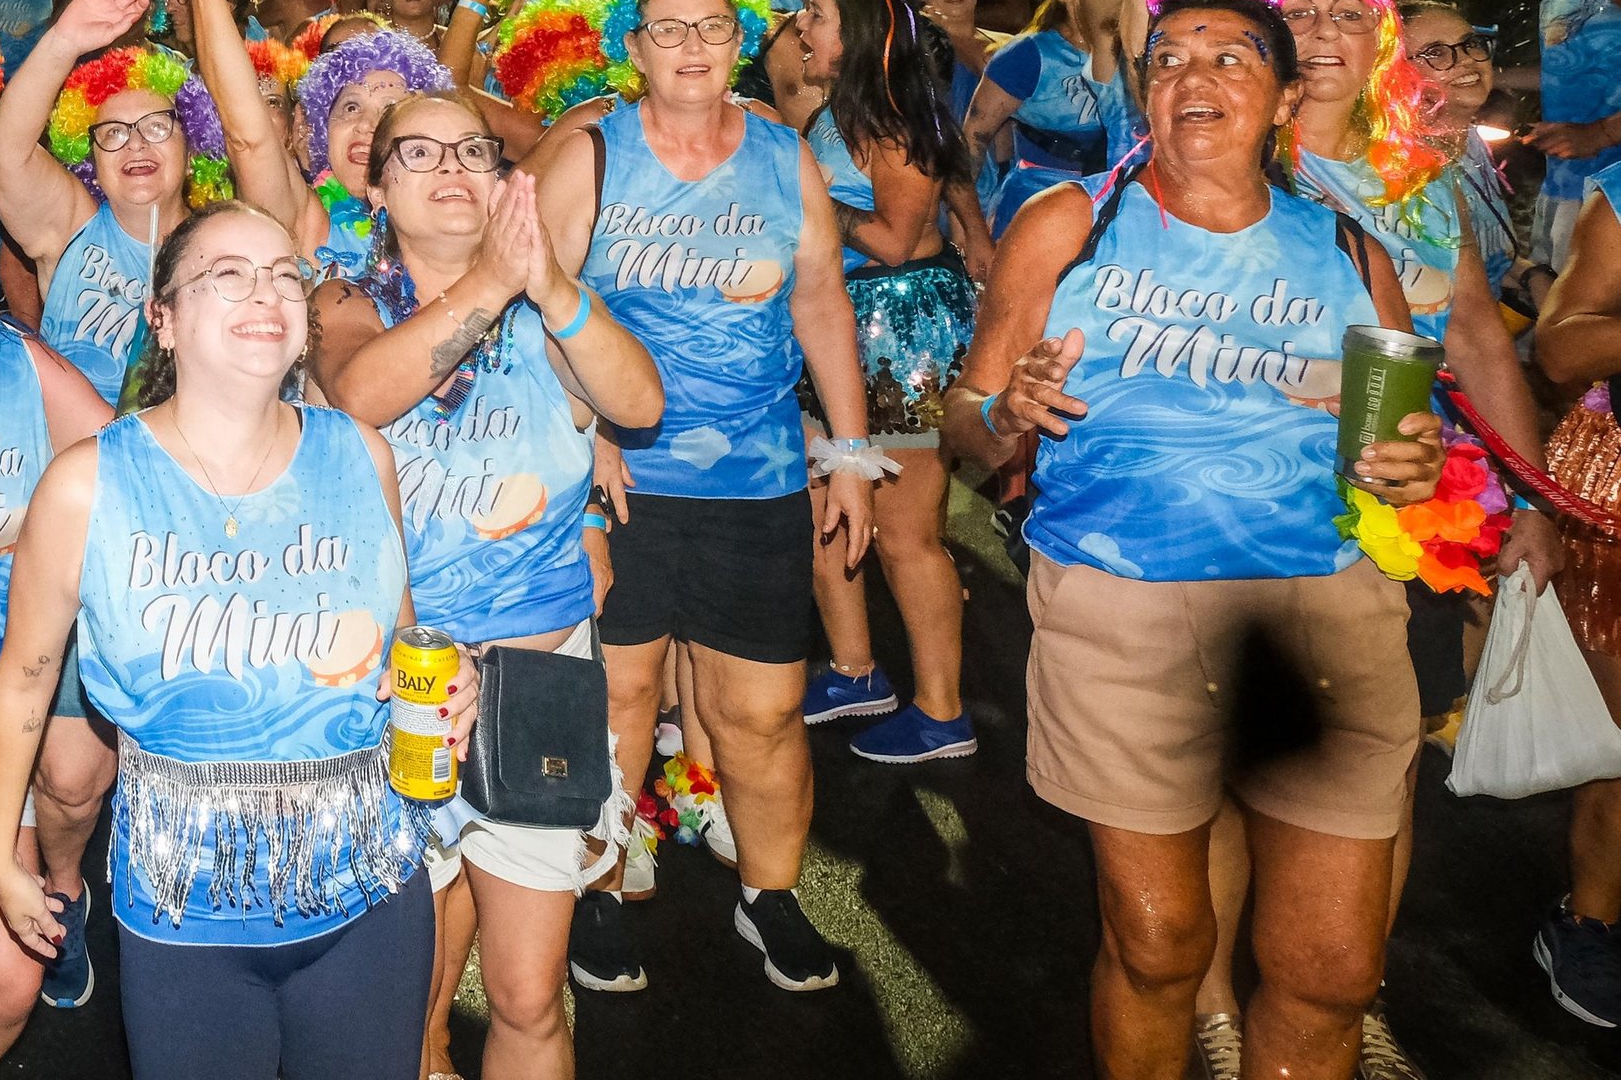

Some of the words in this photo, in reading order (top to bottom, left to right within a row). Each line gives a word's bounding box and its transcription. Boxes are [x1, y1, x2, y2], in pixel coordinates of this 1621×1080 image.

[601, 201, 706, 239] Bloco
[713, 201, 767, 239] da
[606, 238, 754, 295] Mini
[1092, 263, 1240, 323] Bloco
[1250, 277, 1326, 328] da
[1106, 316, 1311, 391] Mini
[128, 530, 270, 593] Bloco
[282, 523, 349, 577] da
[141, 592, 343, 683] Mini
[396, 669, 437, 695] BALY
